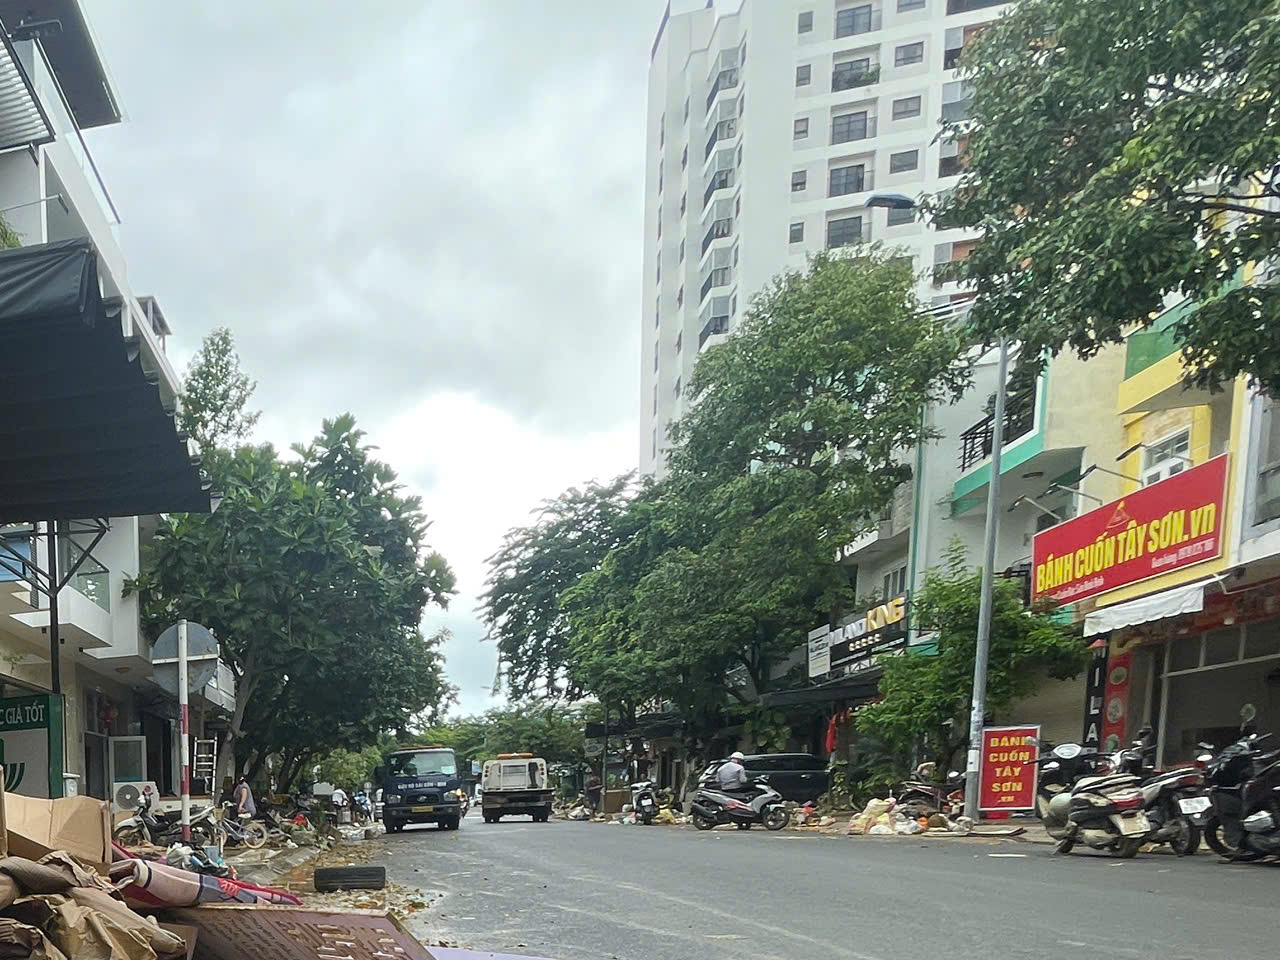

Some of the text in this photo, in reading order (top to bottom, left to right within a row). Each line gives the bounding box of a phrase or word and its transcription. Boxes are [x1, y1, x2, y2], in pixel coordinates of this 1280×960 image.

[1036, 553, 1074, 593] BÁNH
[1074, 531, 1117, 579] CUỐN
[1117, 519, 1148, 564] TÂY
[25, 699, 45, 723] TỐT
[994, 765, 1022, 777] TÂY
